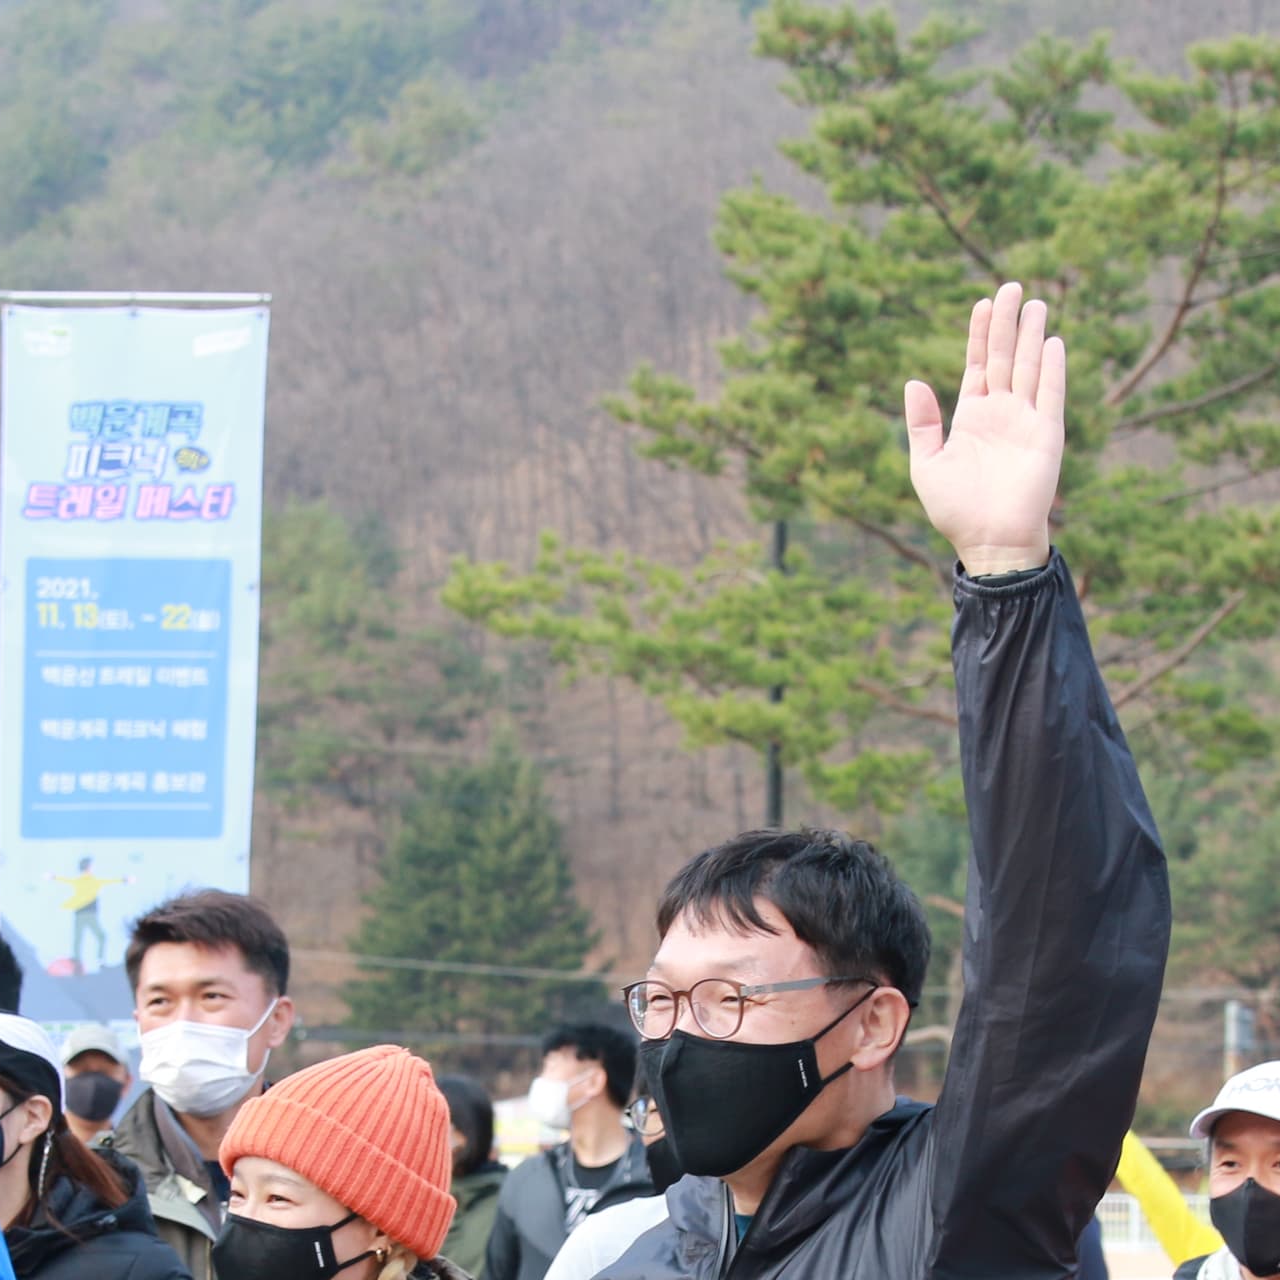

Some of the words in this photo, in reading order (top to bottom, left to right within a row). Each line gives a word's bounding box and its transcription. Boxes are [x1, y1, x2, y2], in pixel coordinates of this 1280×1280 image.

[70, 402, 203, 441] 백운계곡
[66, 443, 168, 481] 피크닉
[22, 483, 128, 520] 트레일
[133, 483, 234, 520] 페스타
[36, 577, 100, 600] 2021.
[99, 666, 152, 688] 트레일
[113, 719, 166, 740] 피크닉
